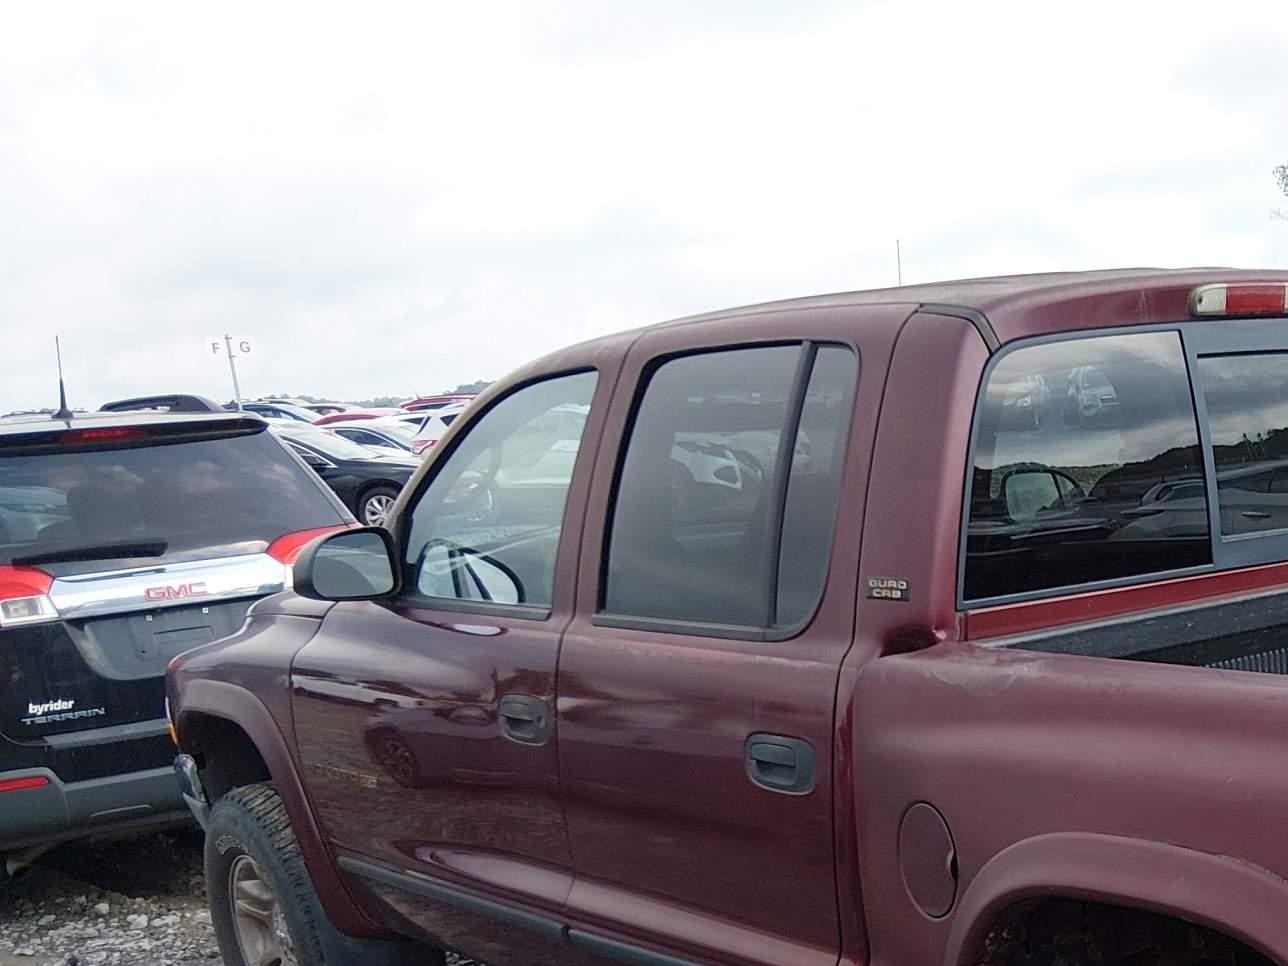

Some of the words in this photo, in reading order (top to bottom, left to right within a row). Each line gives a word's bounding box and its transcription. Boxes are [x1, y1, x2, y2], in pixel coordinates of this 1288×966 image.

[211, 342, 220, 354] F
[239, 341, 251, 353] G
[868, 579, 907, 590] QUAD
[144, 581, 208, 601] GMC
[872, 588, 902, 599] CAB
[28, 699, 75, 715] byrider
